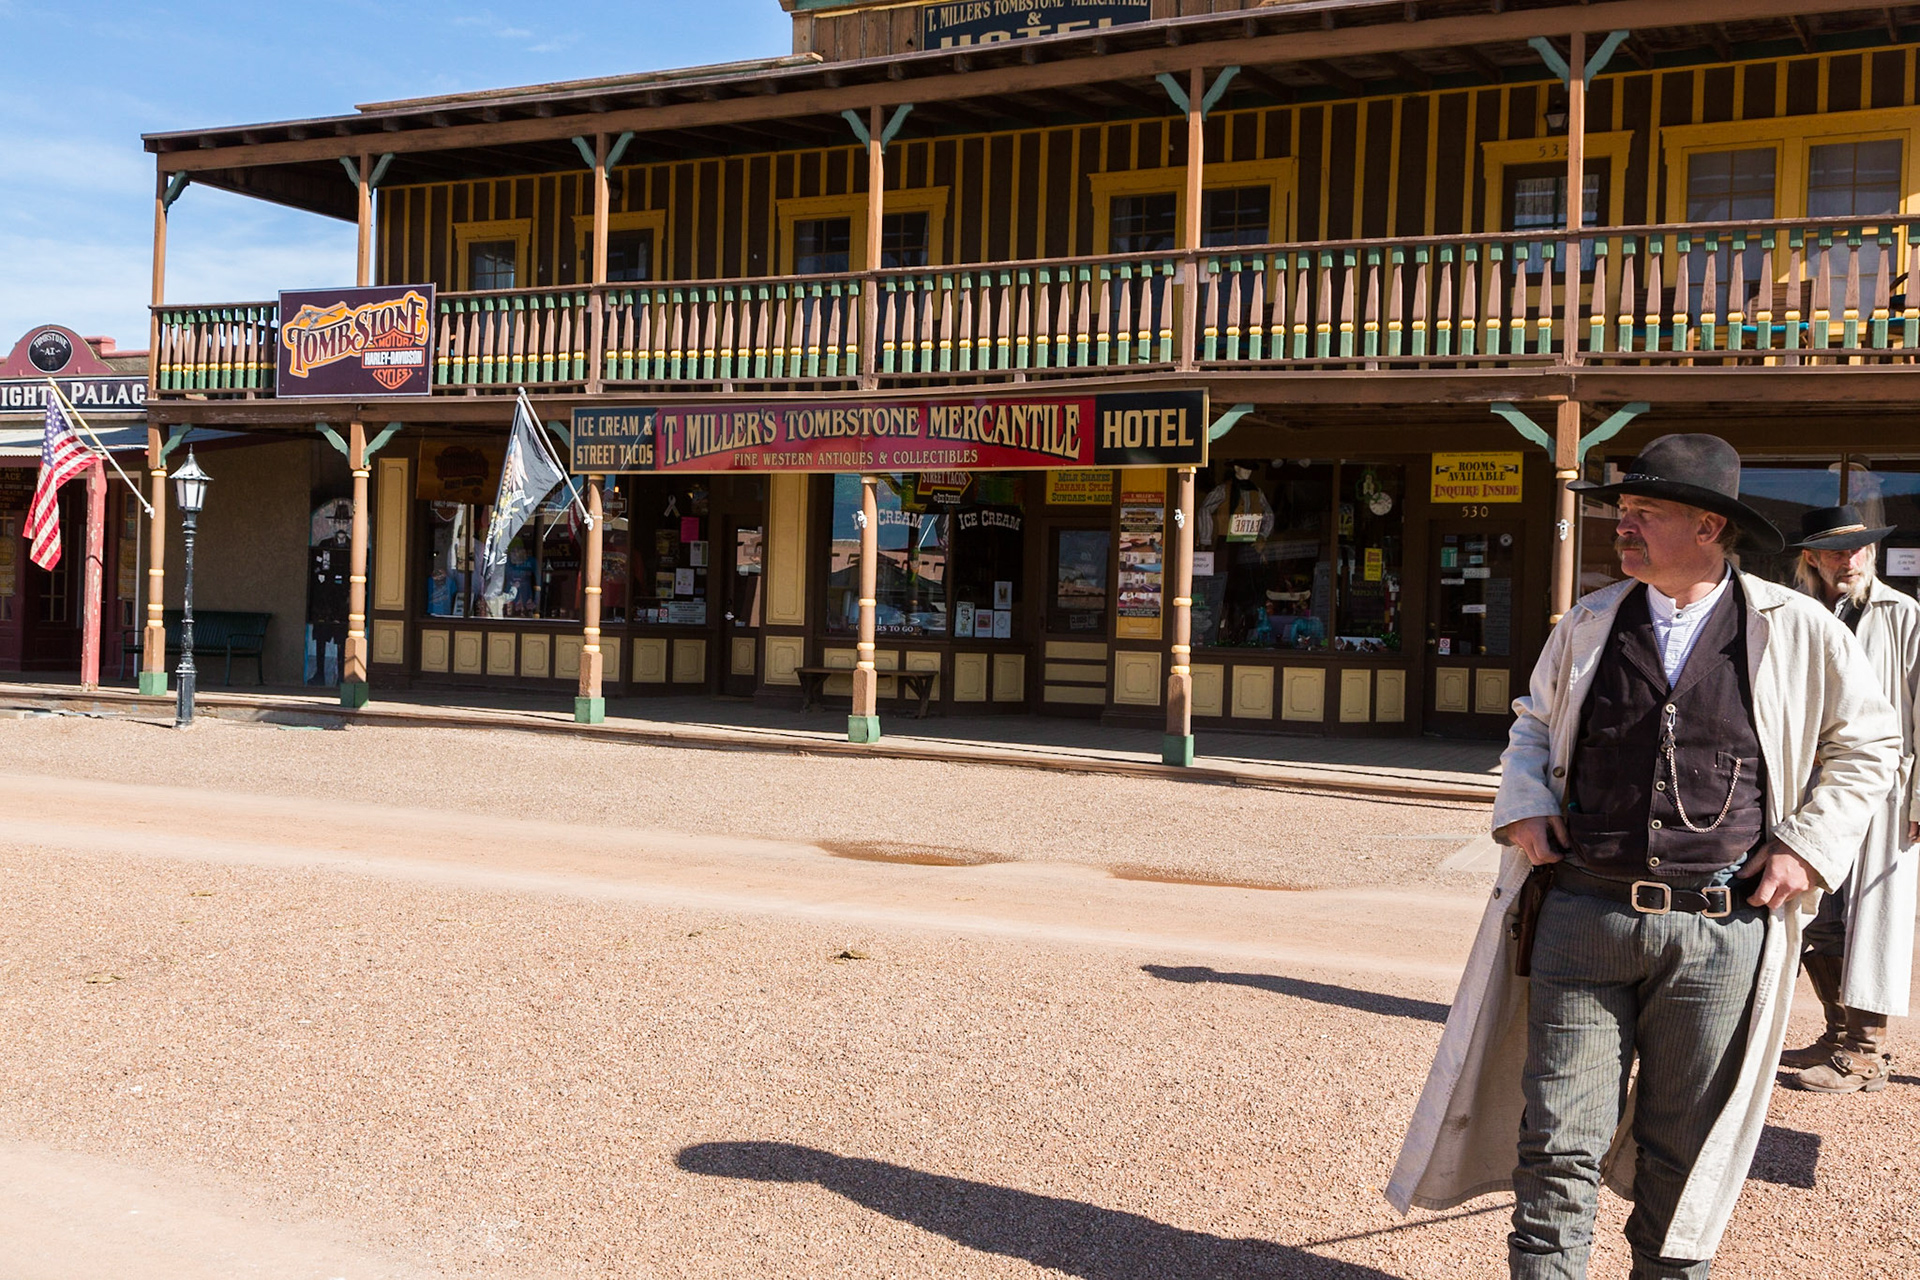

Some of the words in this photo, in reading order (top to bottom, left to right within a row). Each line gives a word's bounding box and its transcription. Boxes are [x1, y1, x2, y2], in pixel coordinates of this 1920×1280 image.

[927, 8, 937, 32] T.
[940, 1, 991, 29] MILLER'S
[1026, 11, 1042, 26] &
[287, 297, 425, 372] TOMBSTONE
[378, 338, 410, 348] MOTOR
[364, 350, 423, 366] HARLEY-DAVIDSON
[376, 369, 409, 386] CYCLES
[70, 382, 149, 405] PALAC
[577, 416, 595, 437] ICE
[598, 415, 639, 436] CREAM
[643, 415, 653, 436] &
[1102, 408, 1195, 449] HOTEL
[664, 415, 680, 465] T.
[685, 408, 777, 459] MILLER'S
[785, 406, 920, 440] TOMBSTONE
[929, 404, 1081, 460] MERCANTILE
[576, 444, 615, 465] STREET
[619, 444, 653, 465] TACOS
[734, 453, 758, 466] FINE
[763, 452, 813, 466] WESTERN
[818, 451, 874, 466] ANTIQUES
[878, 451, 888, 465] &
[893, 450, 978, 465] COLLECTIBLES
[1458, 461, 1496, 472] ROOMS
[922, 472, 946, 485] STREET
[946, 472, 967, 486] TACOS
[1058, 473, 1078, 482] MILK
[1080, 473, 1110, 482] SHAKES
[1447, 471, 1506, 482] AVAILABLE
[1054, 482, 1086, 492] BANANA
[1434, 484, 1479, 499] INQUIRE
[1482, 483, 1519, 498] INSIDE
[1052, 493, 1086, 502] SUNDAES
[877, 508, 925, 529] CREAM
[1462, 505, 1489, 518] 530
[958, 512, 978, 530] ICE
[981, 510, 1022, 531] CREAM
[889, 625, 901, 633] TO
[901, 625, 914, 633] GO
